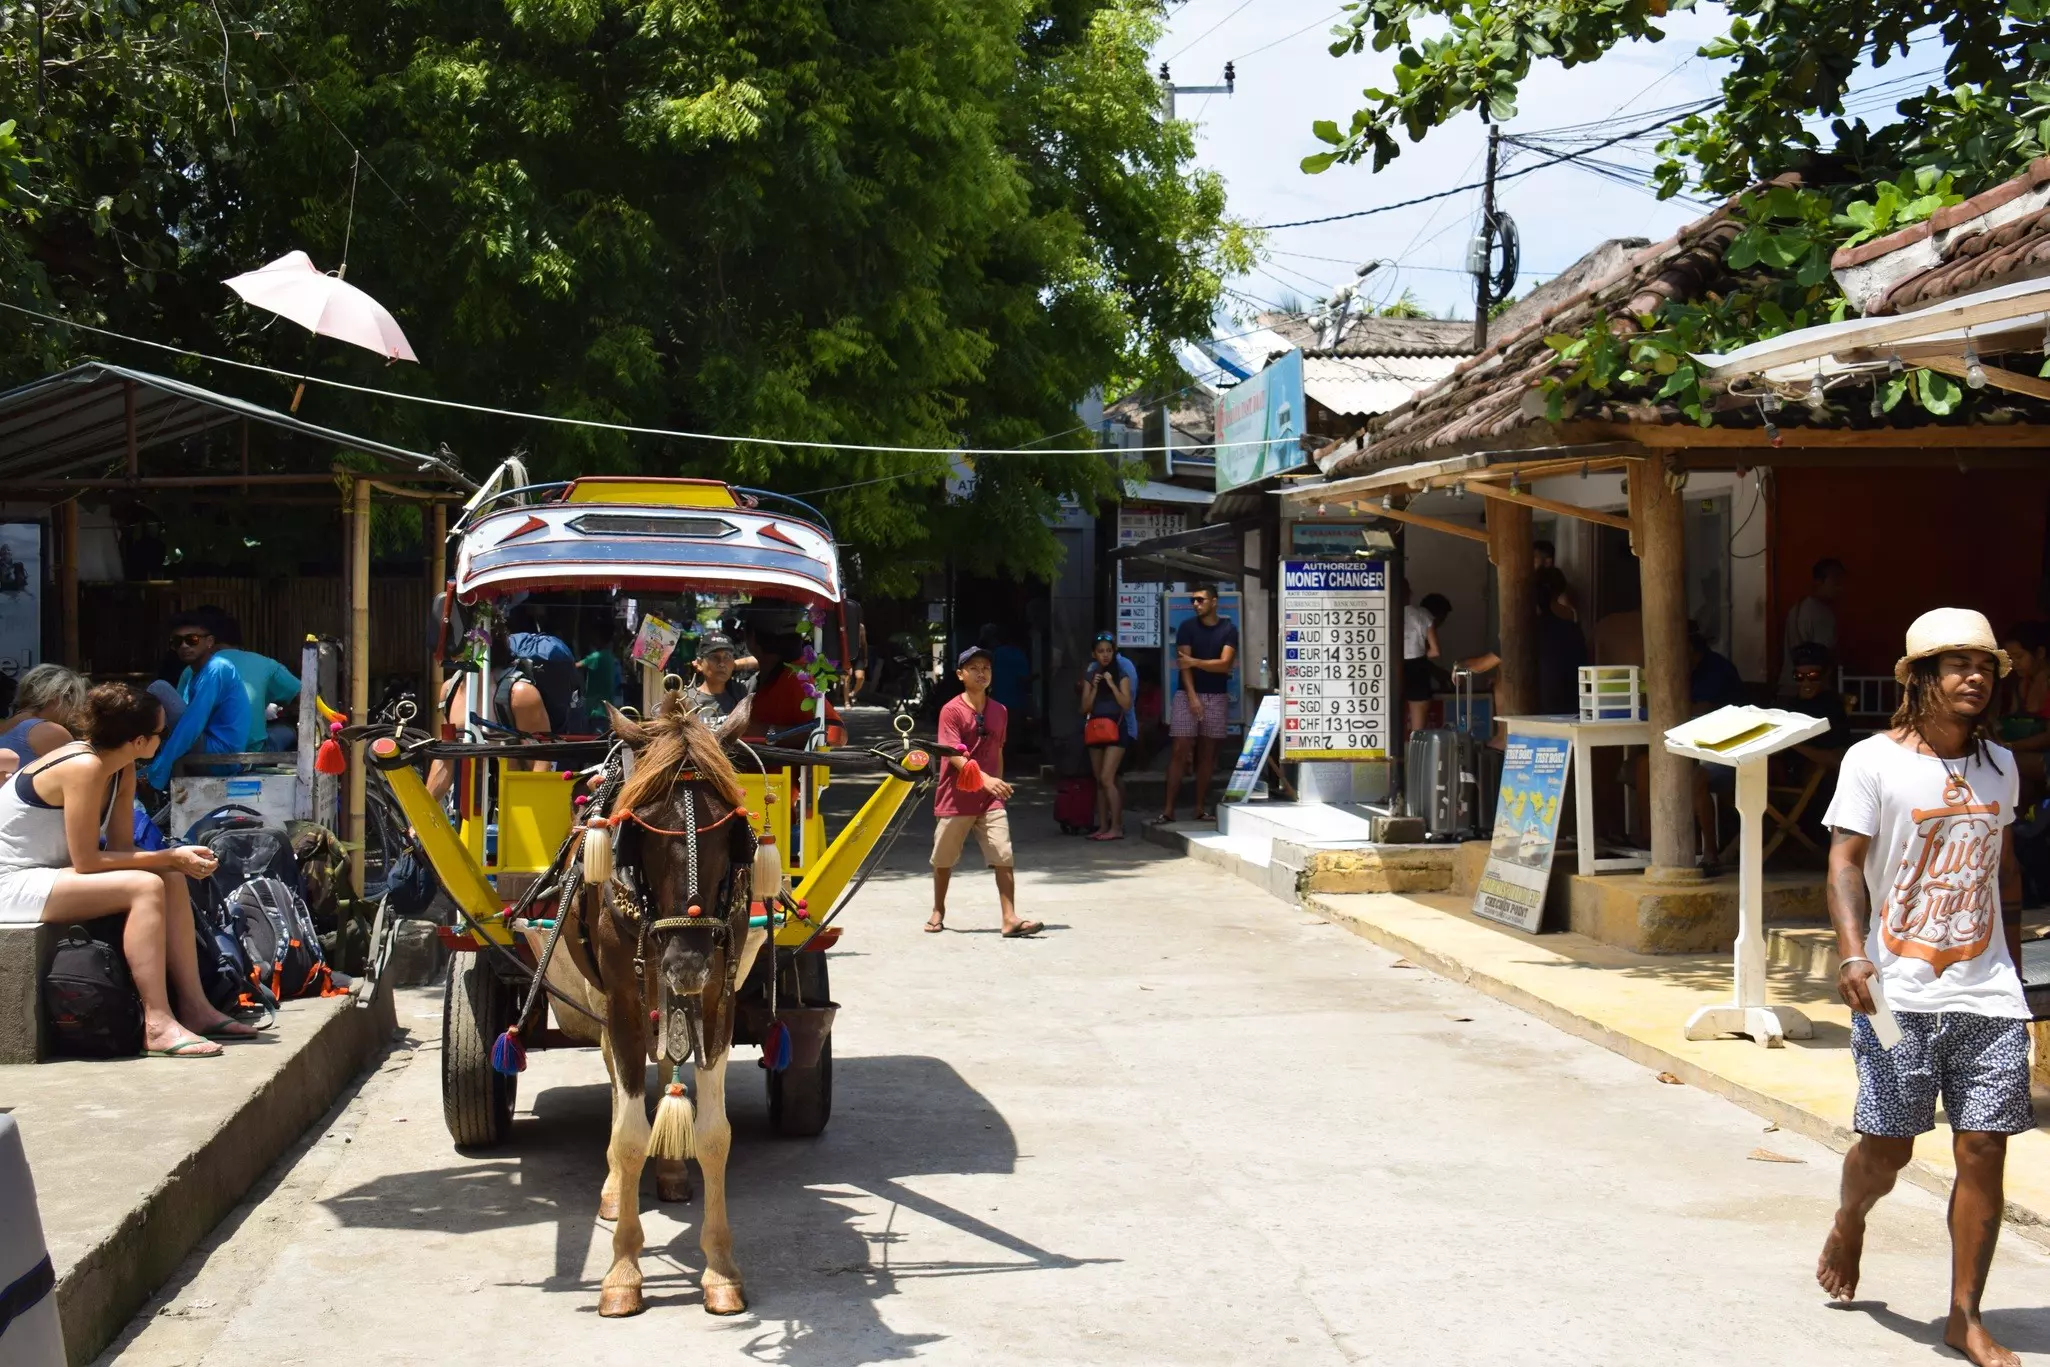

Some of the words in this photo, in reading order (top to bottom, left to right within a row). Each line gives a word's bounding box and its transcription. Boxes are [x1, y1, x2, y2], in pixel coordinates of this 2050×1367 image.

[1303, 562, 1367, 571] AUTHORIZED
[1286, 572, 1326, 587] MONEY
[1328, 572, 1384, 587] CHANGER
[1133, 596, 1145, 604] CAD
[1133, 608, 1145, 616] NZD
[1299, 613, 1321, 625] USD
[1298, 631, 1321, 643] AUD
[1299, 648, 1321, 660] EUR
[1299, 666, 1321, 678] GBP
[1299, 684, 1321, 695] YEN
[1348, 679, 1380, 696] 106
[1299, 701, 1321, 713] SGD
[1299, 718, 1320, 730] CHF
[1298, 736, 1321, 748] MYR
